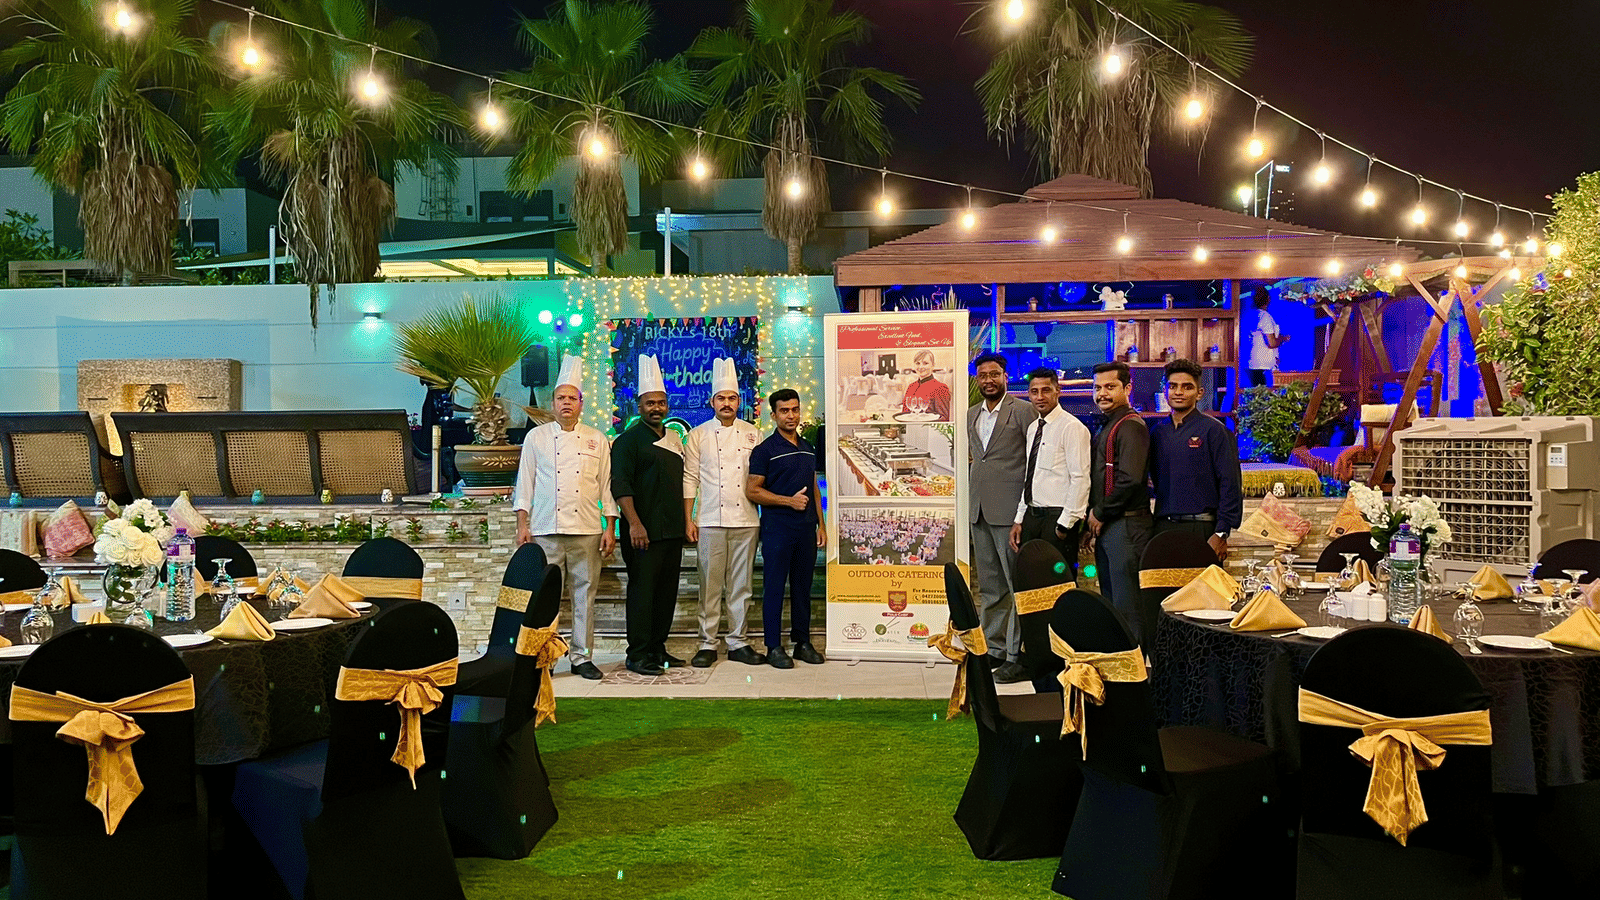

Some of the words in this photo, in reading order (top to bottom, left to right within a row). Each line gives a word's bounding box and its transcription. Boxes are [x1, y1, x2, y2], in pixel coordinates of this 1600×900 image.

[645, 326, 695, 340] RICKY's
[703, 325, 732, 338] 18th
[839, 325, 878, 333] Professional
[878, 332, 906, 340] Excellent
[903, 338, 927, 347] Elegant
[927, 338, 940, 346] Set
[940, 337, 952, 346] Up
[660, 342, 711, 368] Happy
[660, 365, 713, 388] irthda
[848, 570, 895, 579] OUTDOOR
[891, 579, 902, 588] by
